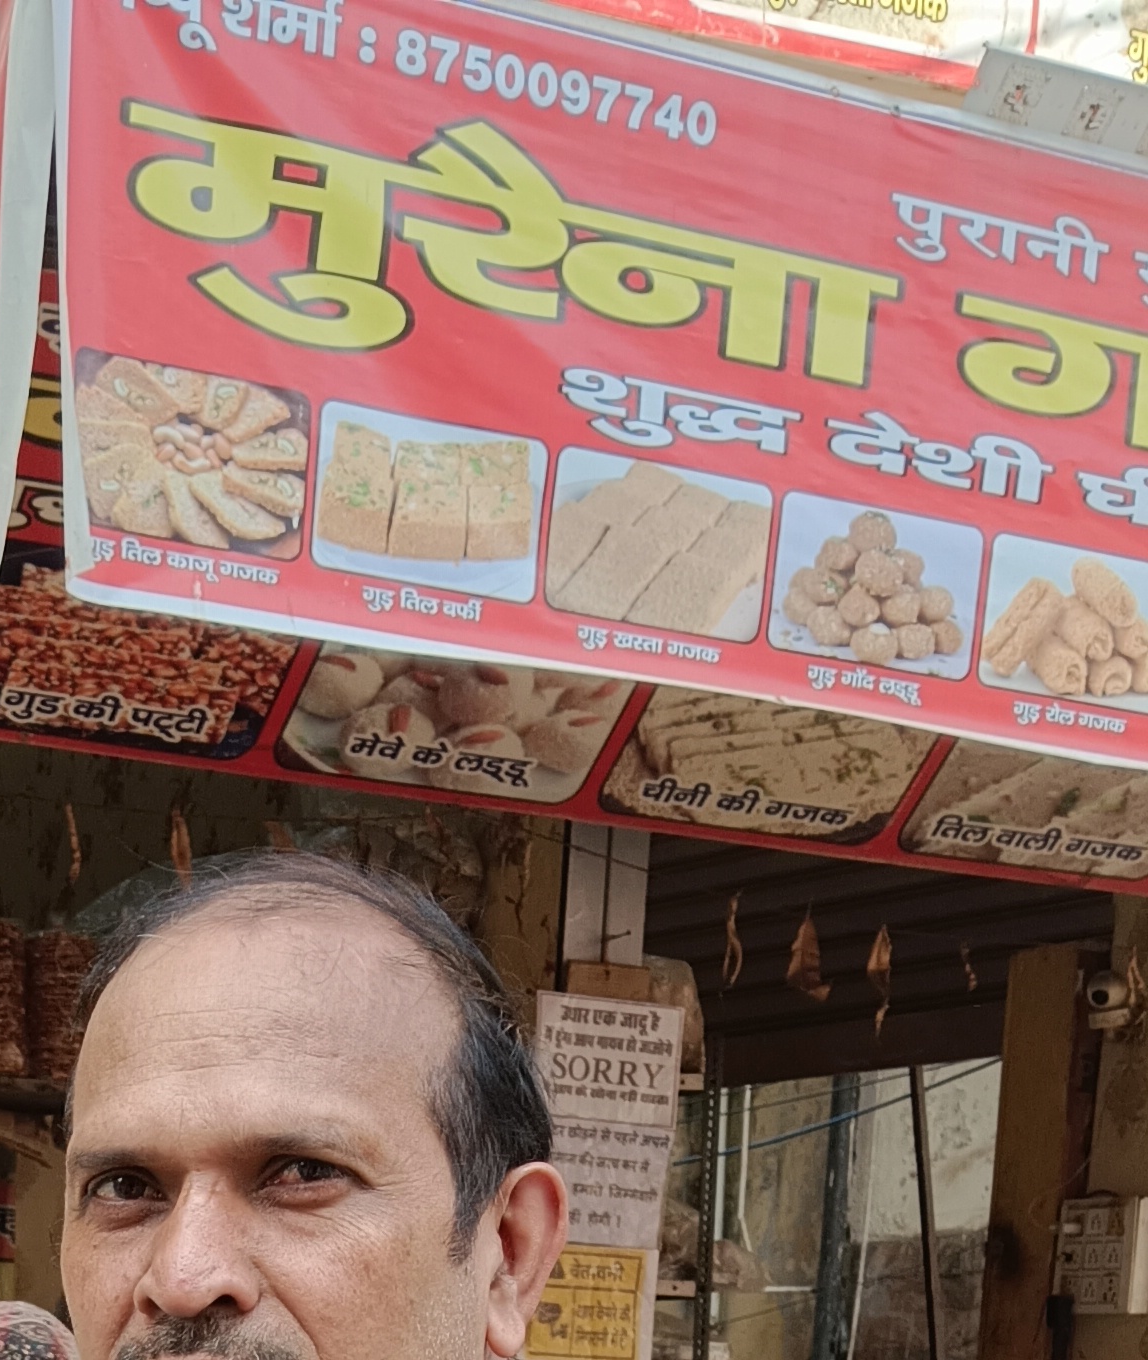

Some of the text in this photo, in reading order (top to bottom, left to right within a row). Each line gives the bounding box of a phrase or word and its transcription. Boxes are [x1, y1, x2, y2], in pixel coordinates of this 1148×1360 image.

[395, 29, 716, 146] 8750097740
[892, 192, 1110, 284] पुरानी
[825, 411, 1054, 504] देशी
[120, 538, 163, 566] तिल
[220, 561, 280, 585] गजक
[400, 587, 440, 615] तिल
[667, 640, 722, 664] गजक
[73, 695, 123, 723] की
[1078, 711, 1127, 733] गजक
[350, 733, 405, 759] मेवे
[412, 742, 450, 764] के
[642, 778, 855, 826] चीनी की गजक
[932, 814, 1148, 862] तिल वाली गजक
[551, 1052, 665, 1090] SORRY
